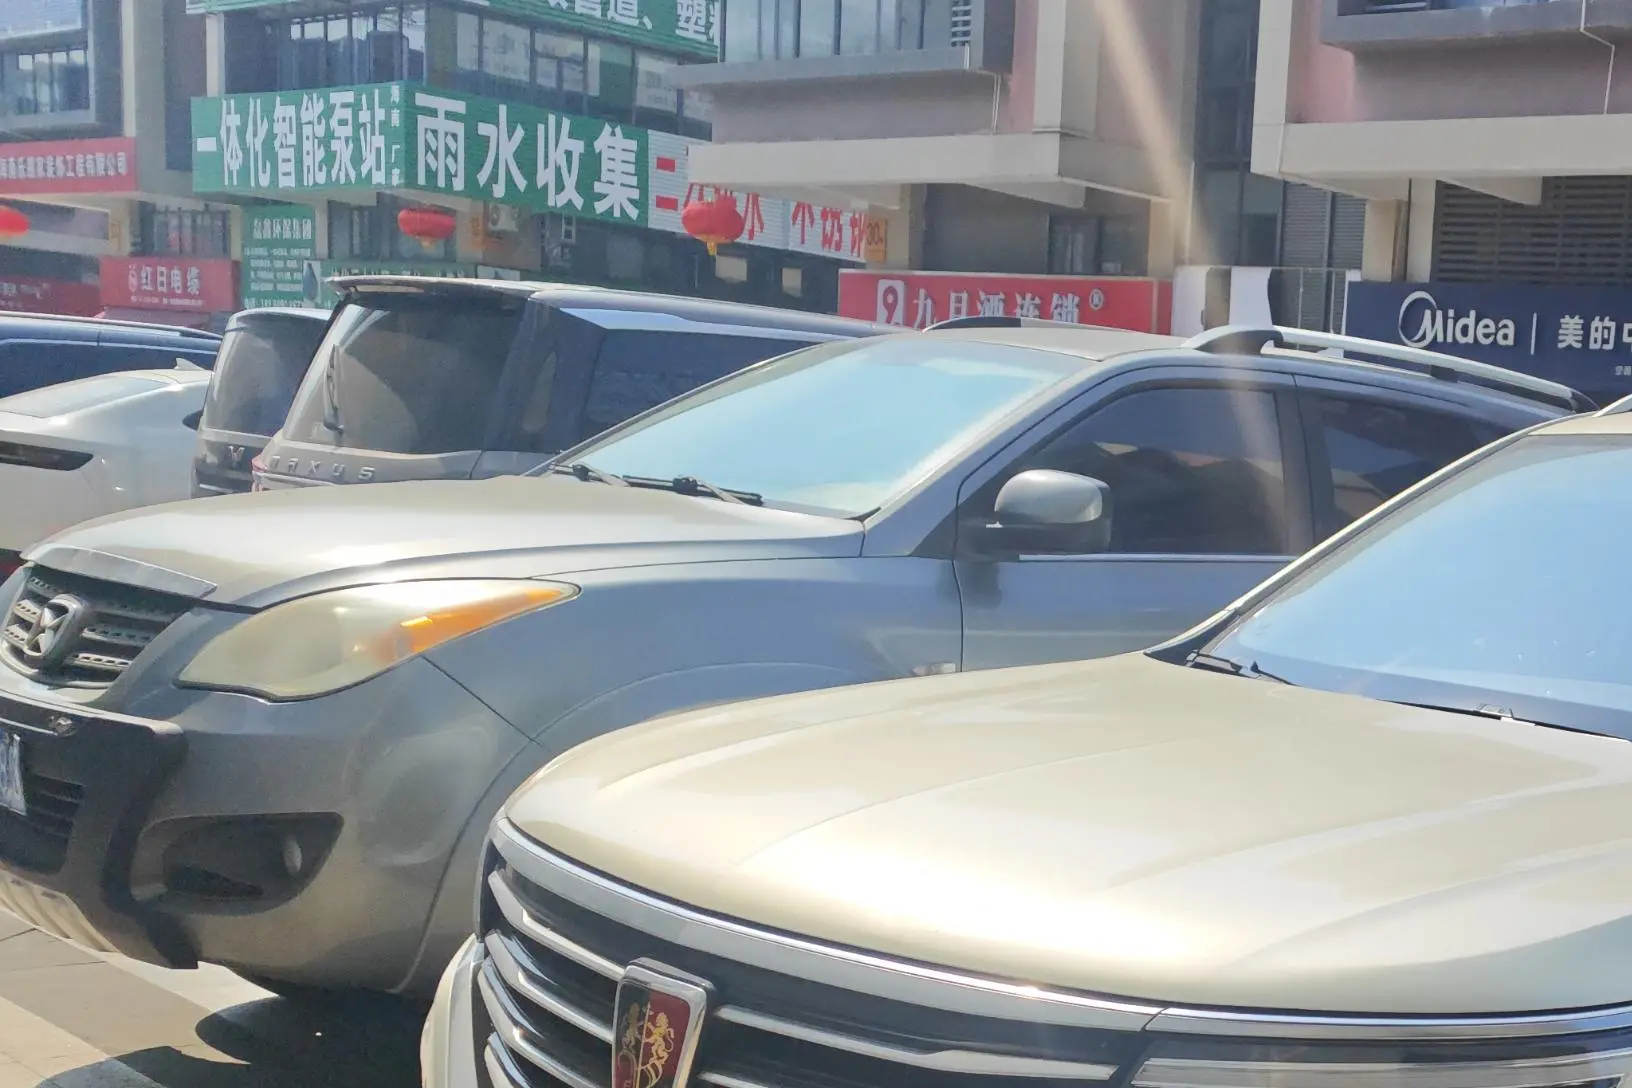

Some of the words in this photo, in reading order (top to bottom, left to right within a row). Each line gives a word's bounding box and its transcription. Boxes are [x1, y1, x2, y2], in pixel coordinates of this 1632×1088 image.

[196, 88, 386, 189] 一体化智能泵站
[415, 92, 641, 221] 雨水收集
[1398, 290, 1515, 348] Midea
